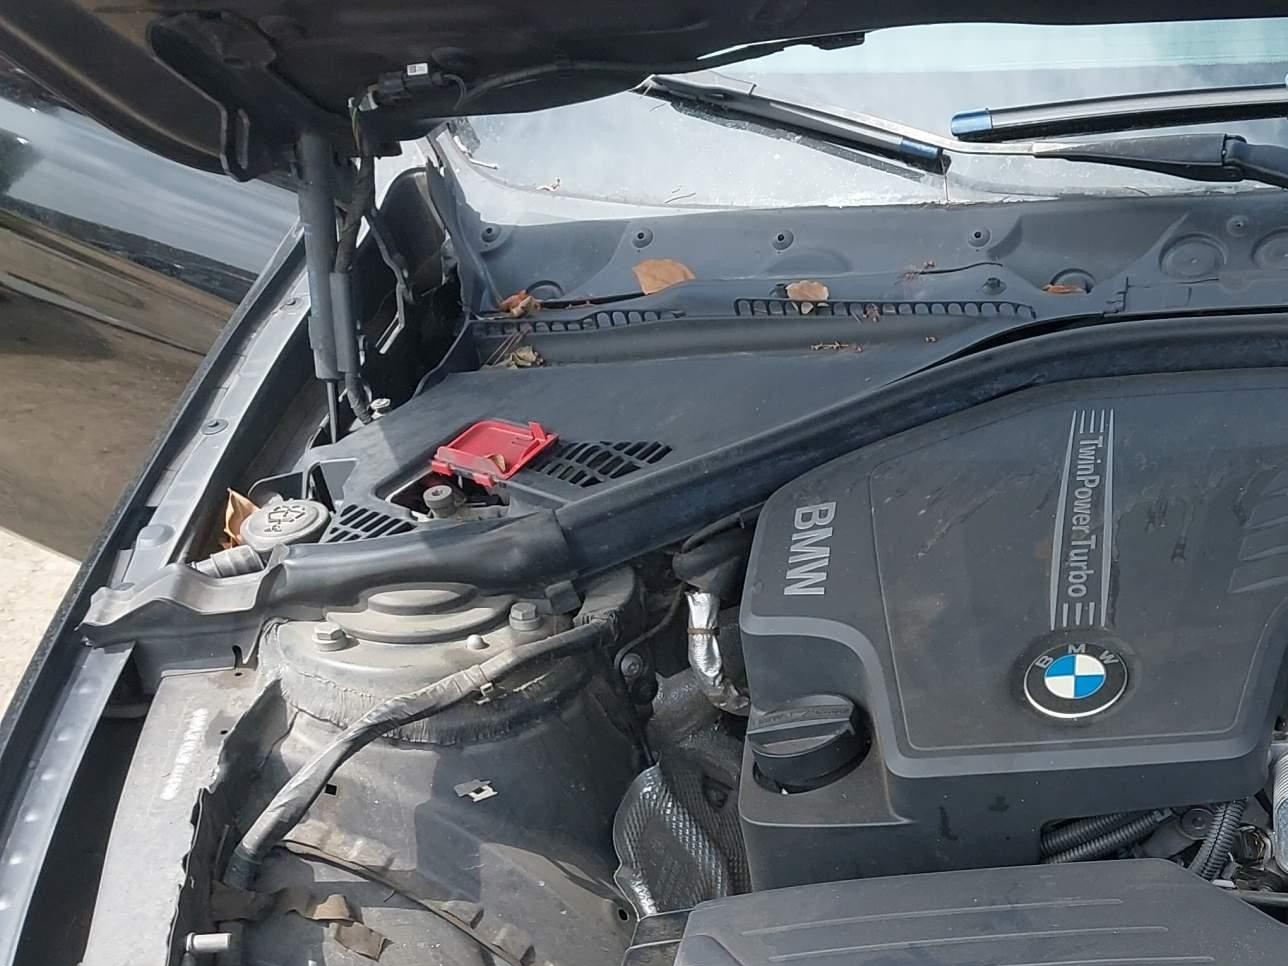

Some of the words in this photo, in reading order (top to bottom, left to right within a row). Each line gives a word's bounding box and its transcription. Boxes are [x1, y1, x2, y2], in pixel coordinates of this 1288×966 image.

[784, 502, 836, 595] BMW
[1067, 435, 1103, 598] TwinPowerTurbo
[1035, 643, 1119, 668] BMW
